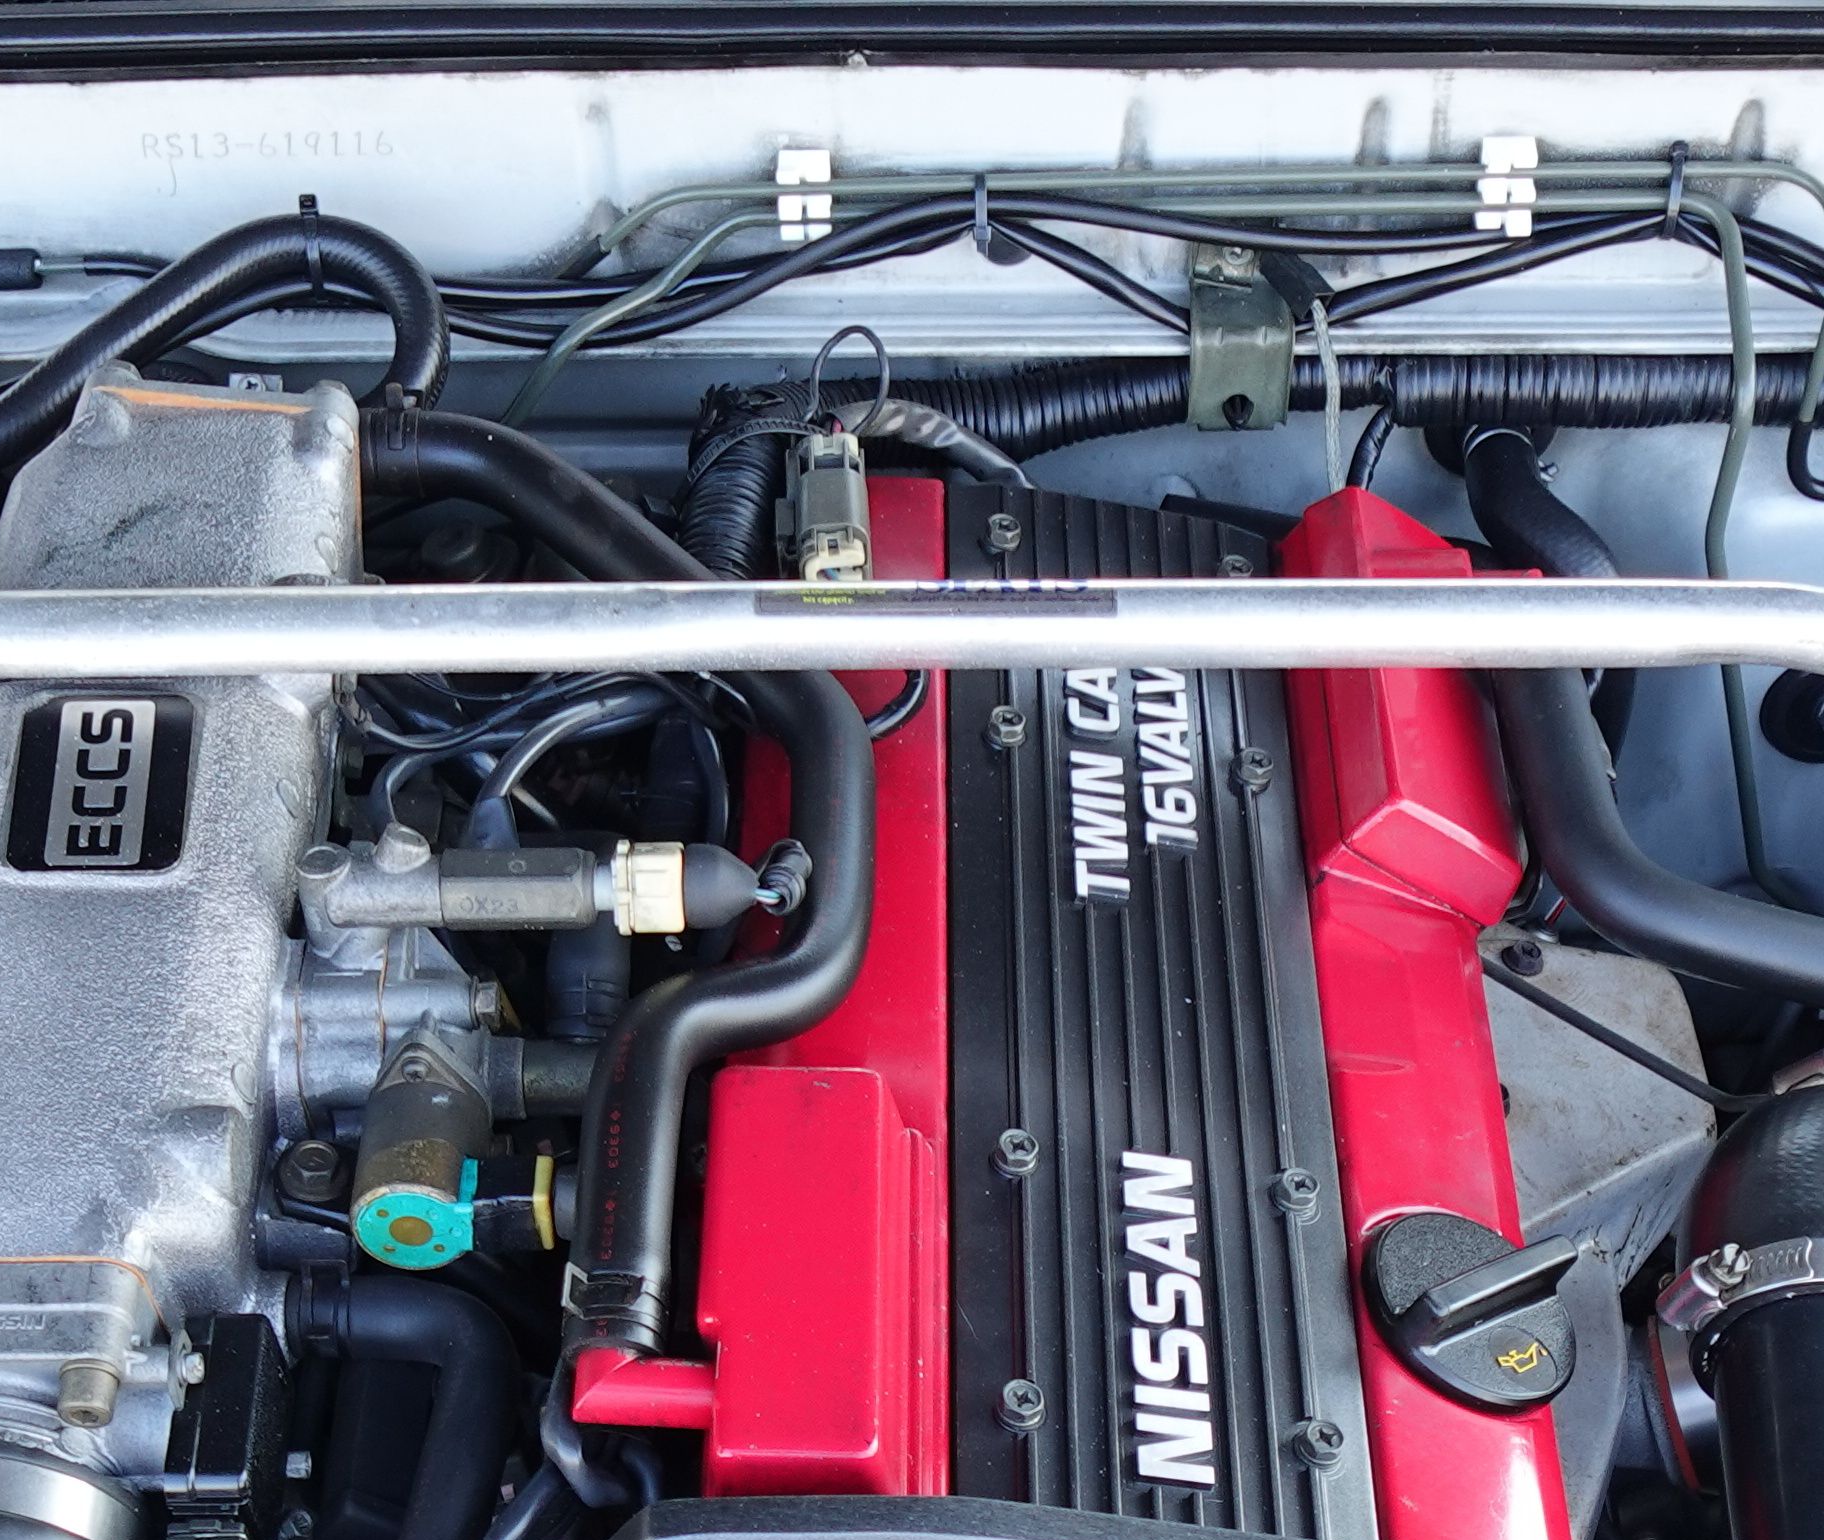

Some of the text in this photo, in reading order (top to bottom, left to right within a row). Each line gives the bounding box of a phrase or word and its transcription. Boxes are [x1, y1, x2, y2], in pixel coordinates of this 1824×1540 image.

[140, 130, 394, 160] RS13-619116
[68, 707, 133, 858] ECCS
[1063, 667, 1132, 905] TWIN CA
[1133, 667, 1201, 856] 16VALV
[1121, 1150, 1219, 1487] NISSAN
